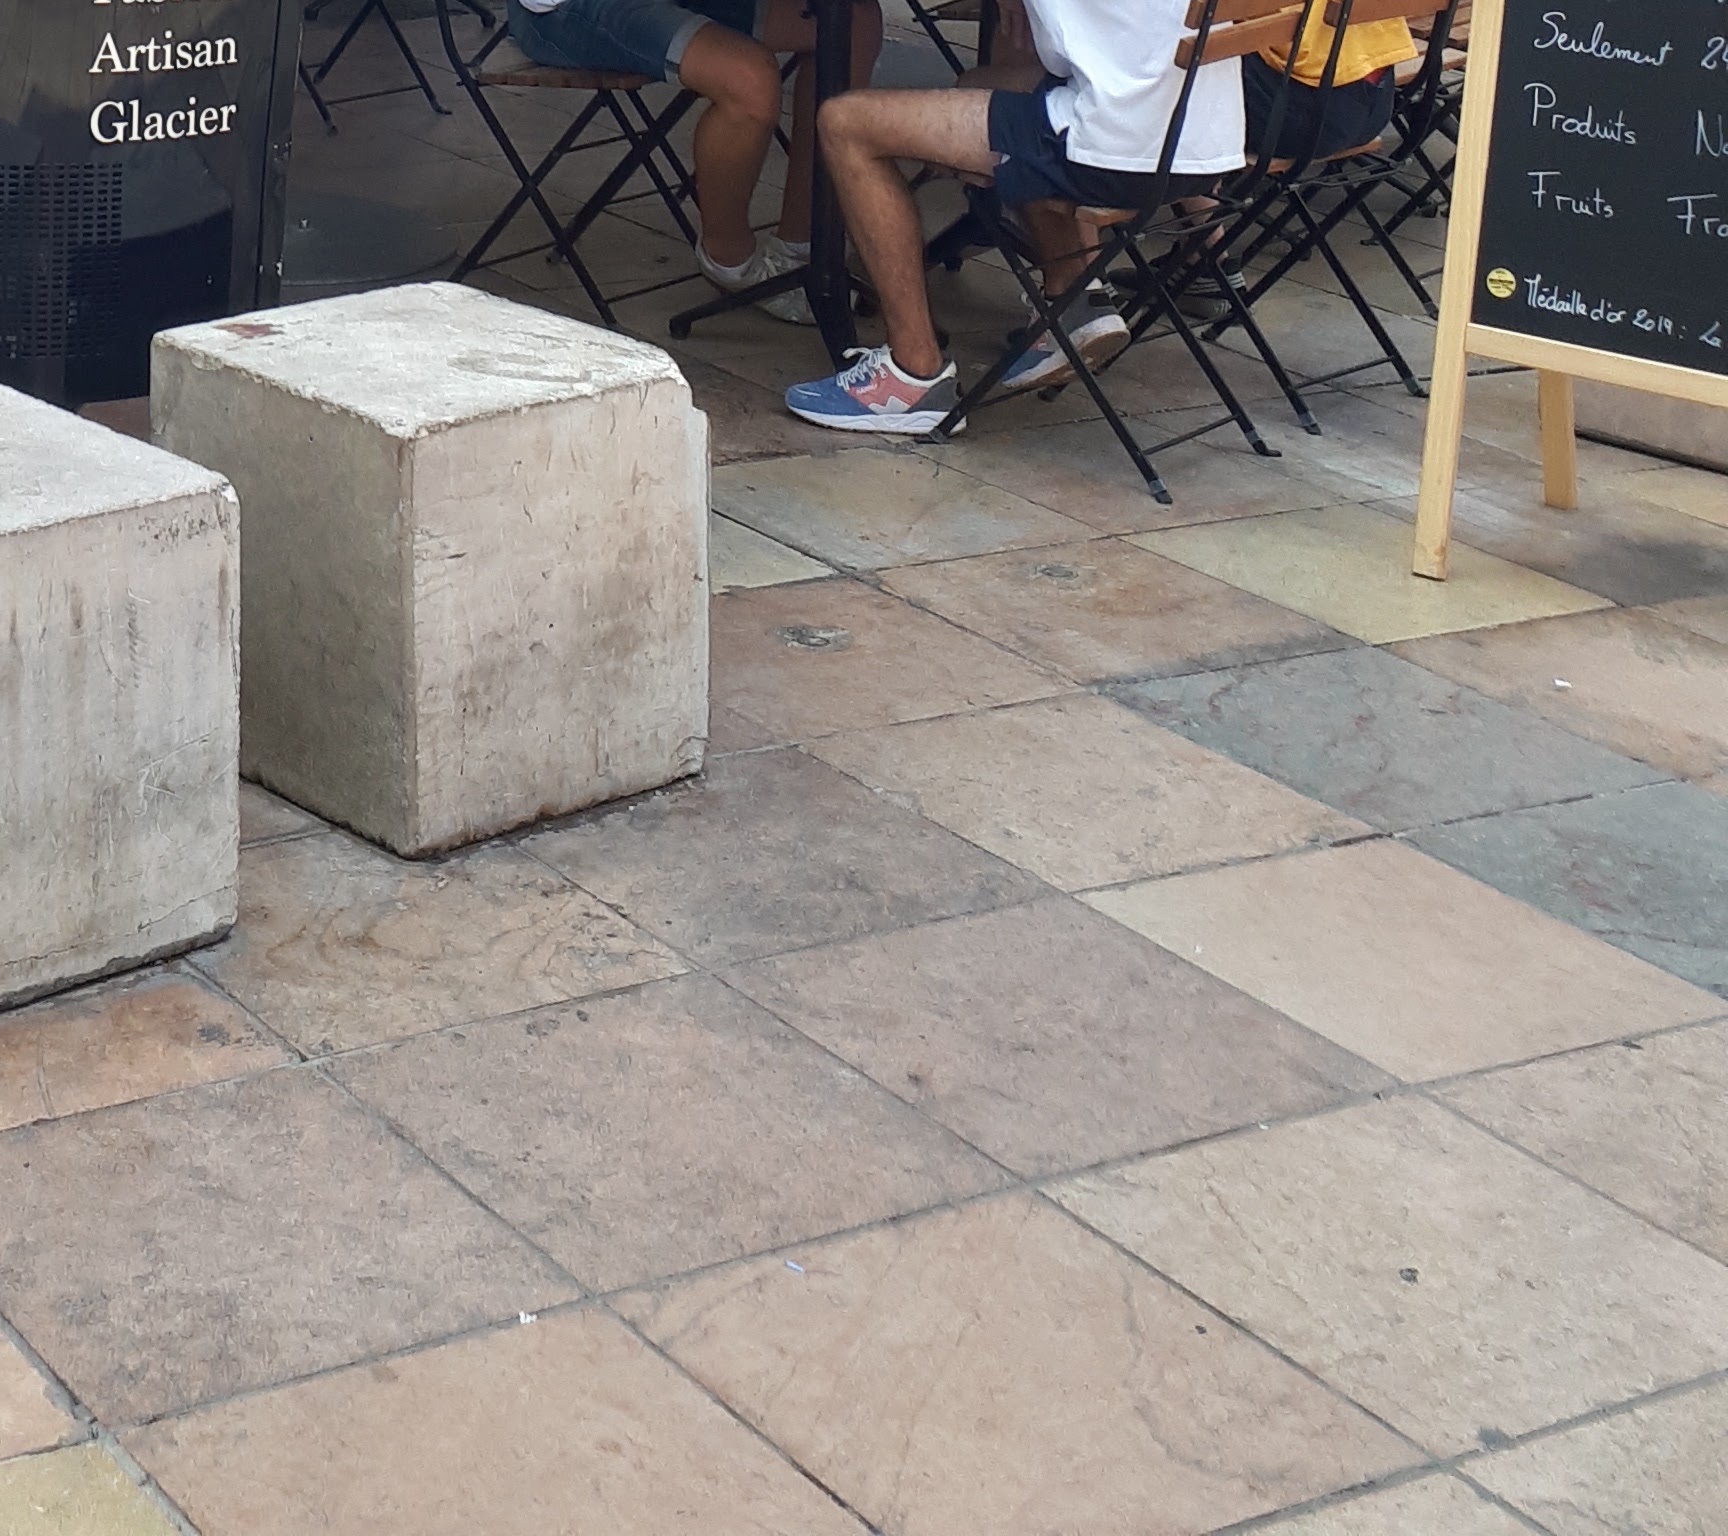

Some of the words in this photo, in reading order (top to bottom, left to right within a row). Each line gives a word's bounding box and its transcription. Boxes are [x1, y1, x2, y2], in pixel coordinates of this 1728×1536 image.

[89, 30, 238, 74] Artisan
[1534, 11, 1673, 66] Seulement
[90, 96, 237, 144] Glacier
[1523, 83, 1636, 145] Produits
[1527, 171, 1614, 218] Fruits
[1590, 298, 1627, 324] d'or
